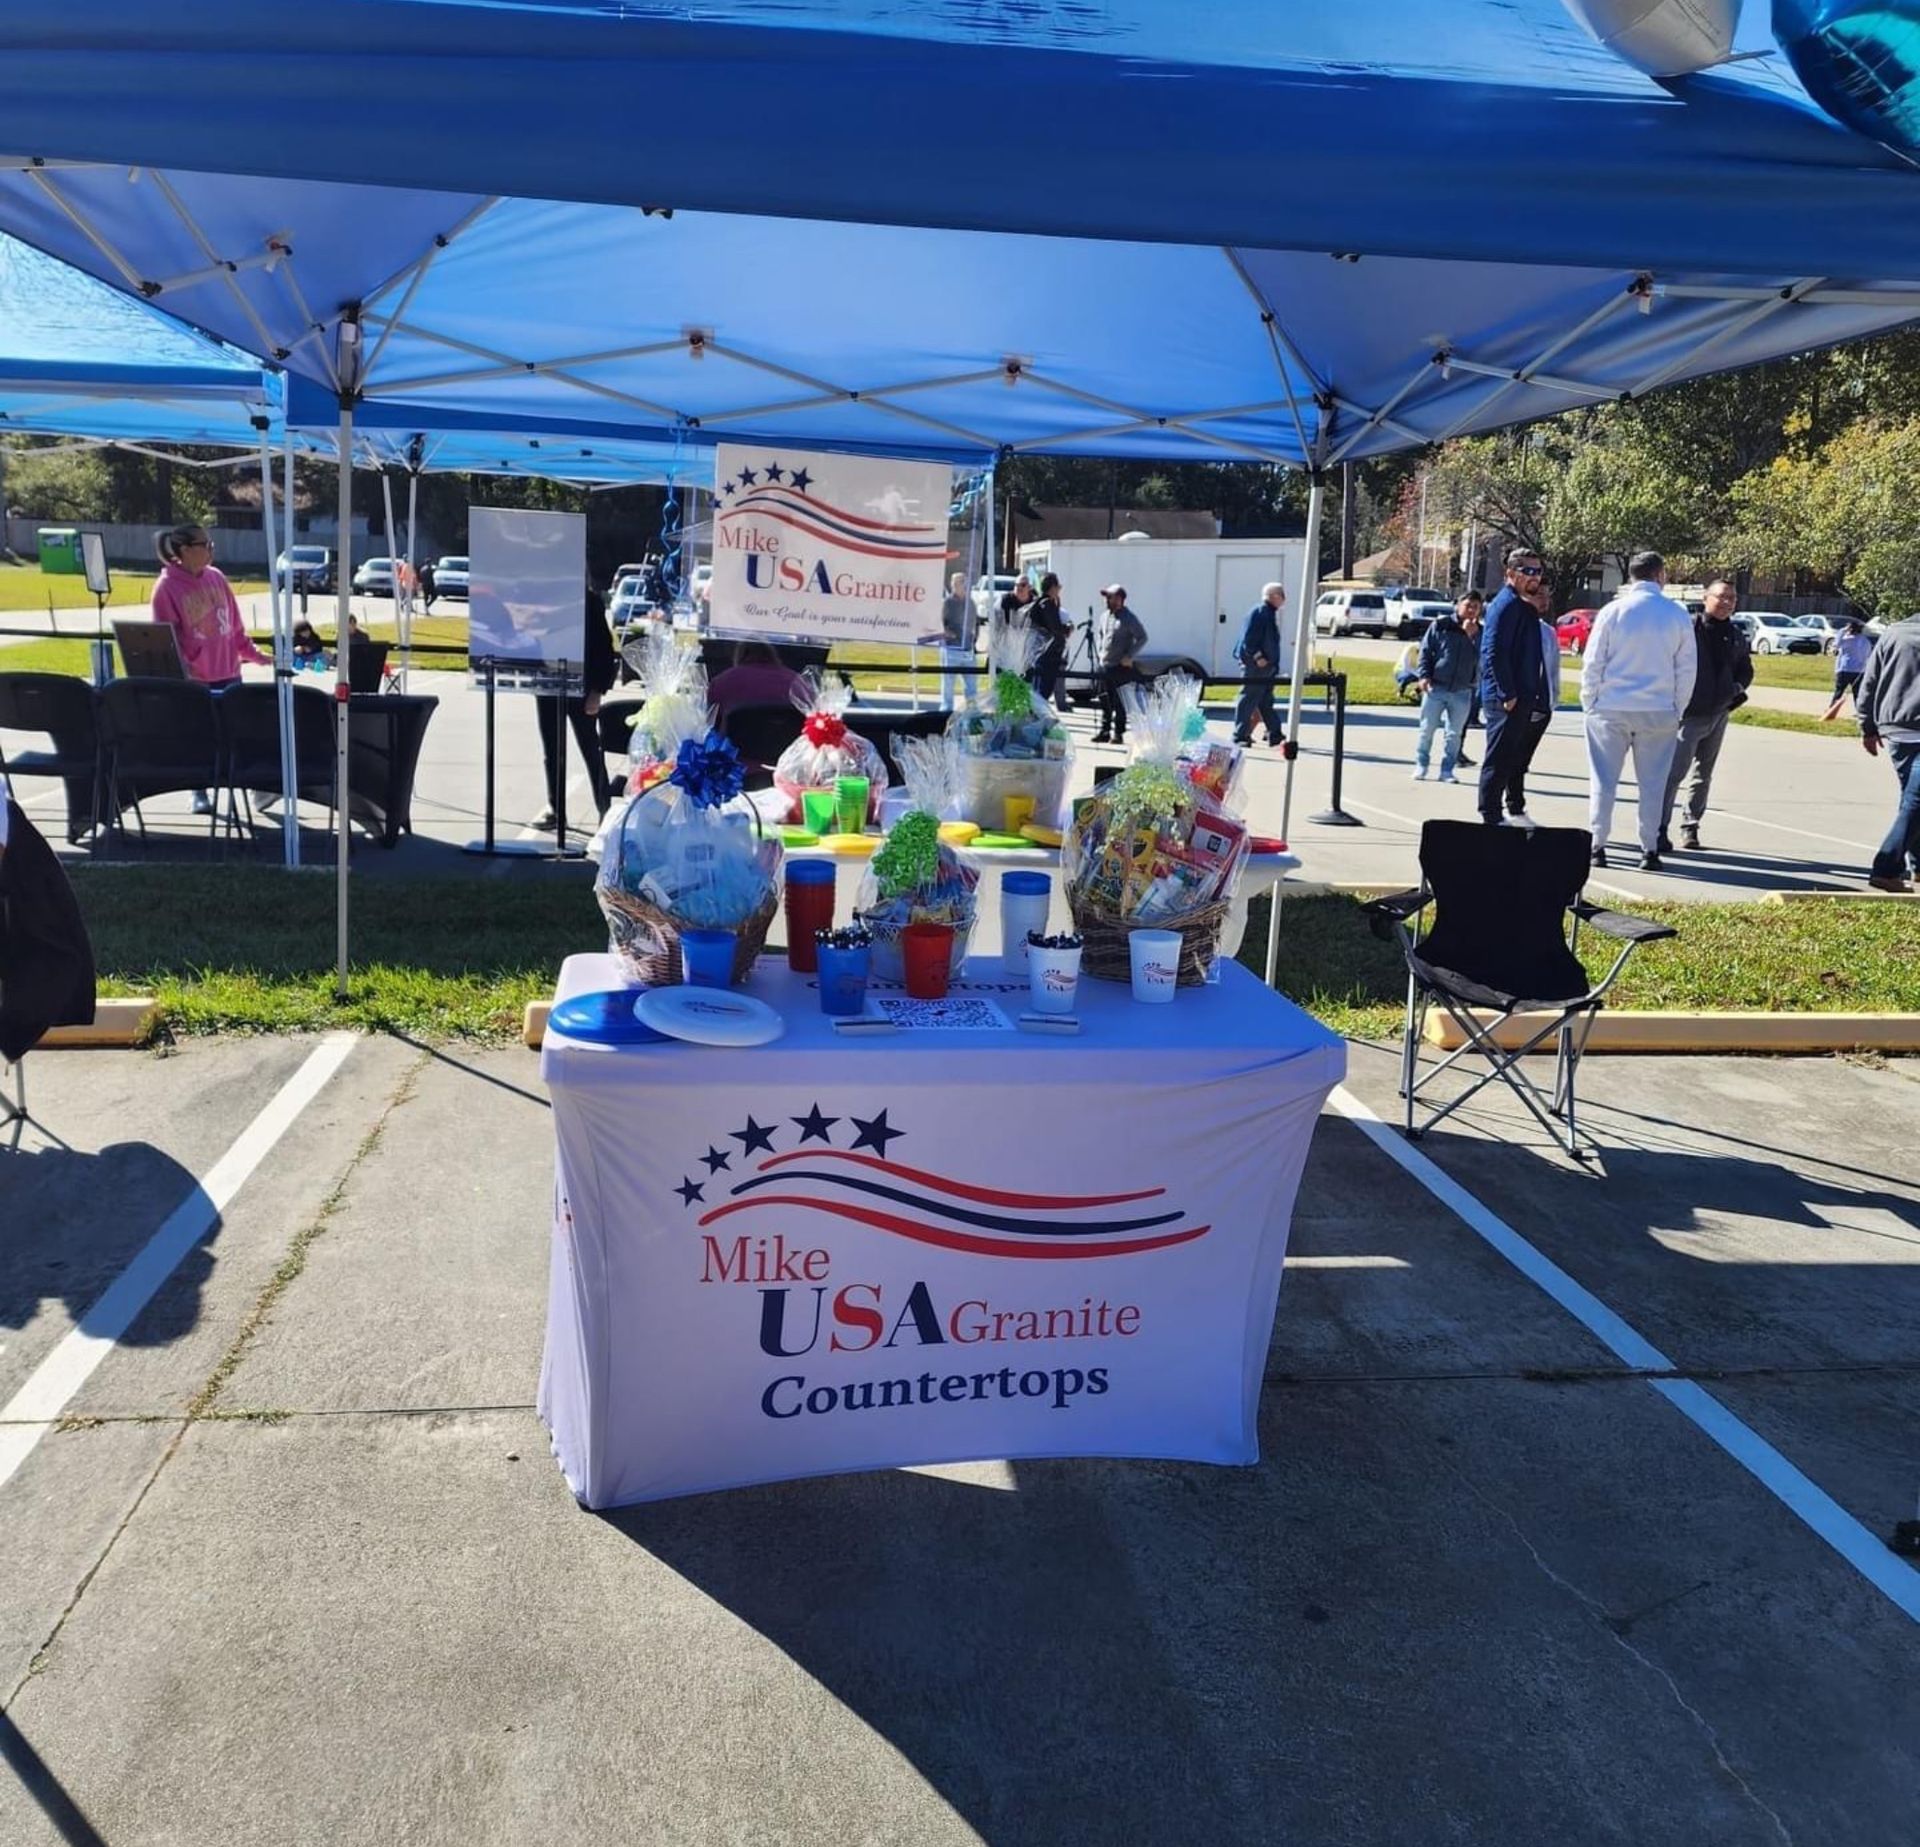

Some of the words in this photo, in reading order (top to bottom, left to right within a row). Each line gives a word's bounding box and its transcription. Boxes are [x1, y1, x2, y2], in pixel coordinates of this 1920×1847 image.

[718, 525, 780, 553] Mike
[745, 553, 833, 595] USA
[834, 573, 926, 602] Granite
[744, 603, 768, 617] Our
[772, 606, 806, 622] Goal
[808, 611, 819, 621] is
[821, 615, 846, 625] your
[849, 613, 911, 629] satisfaction
[700, 1235, 830, 1283] Mike
[757, 1281, 948, 1357] USA
[949, 1298, 1141, 1343] Granite
[760, 1367, 1109, 1419] Countertops
